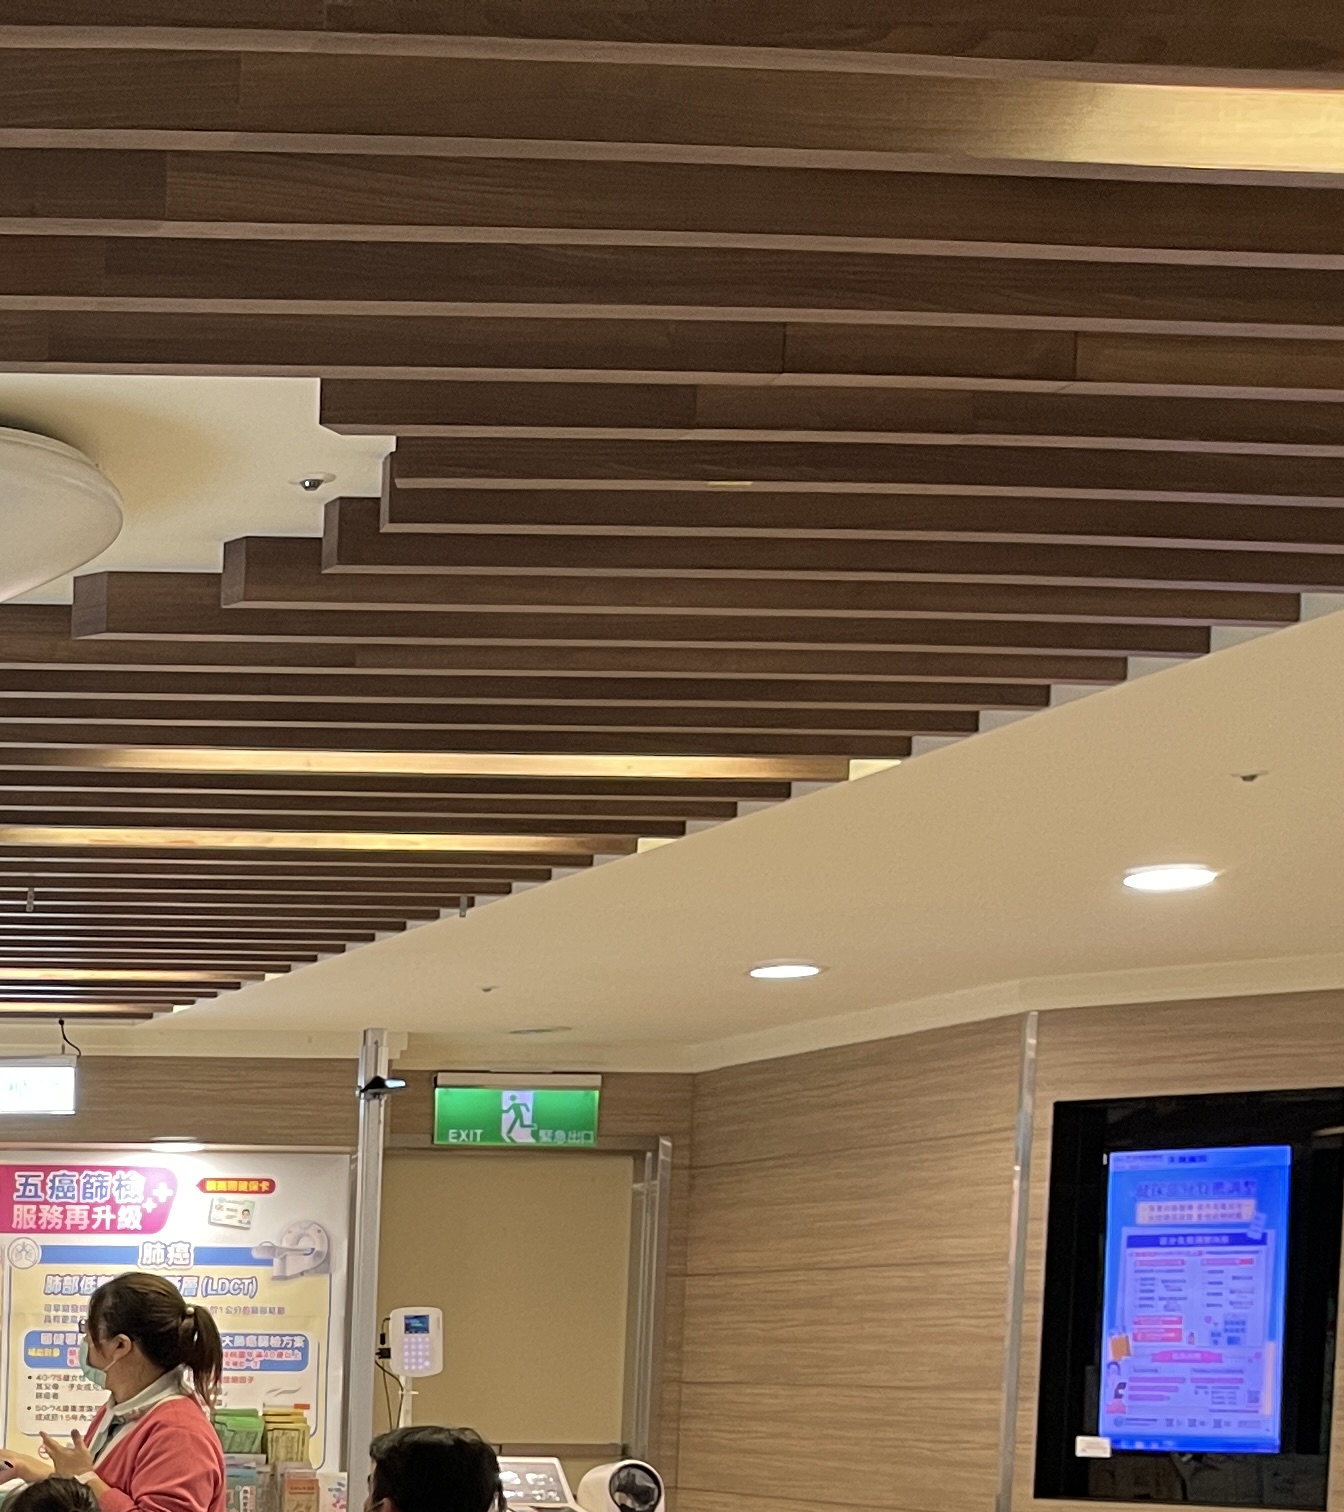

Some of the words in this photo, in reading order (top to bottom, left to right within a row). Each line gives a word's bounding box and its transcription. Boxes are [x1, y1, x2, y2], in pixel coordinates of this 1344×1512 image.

[448, 1129, 484, 1143] EXIT
[538, 1130, 595, 1144] 緊急出口
[12, 1170, 145, 1204] 五癌篩檢
[11, 1203, 143, 1231] 服務再升級
[138, 1240, 192, 1267] 肺癌
[201, 1276, 258, 1300] (LDCT)
